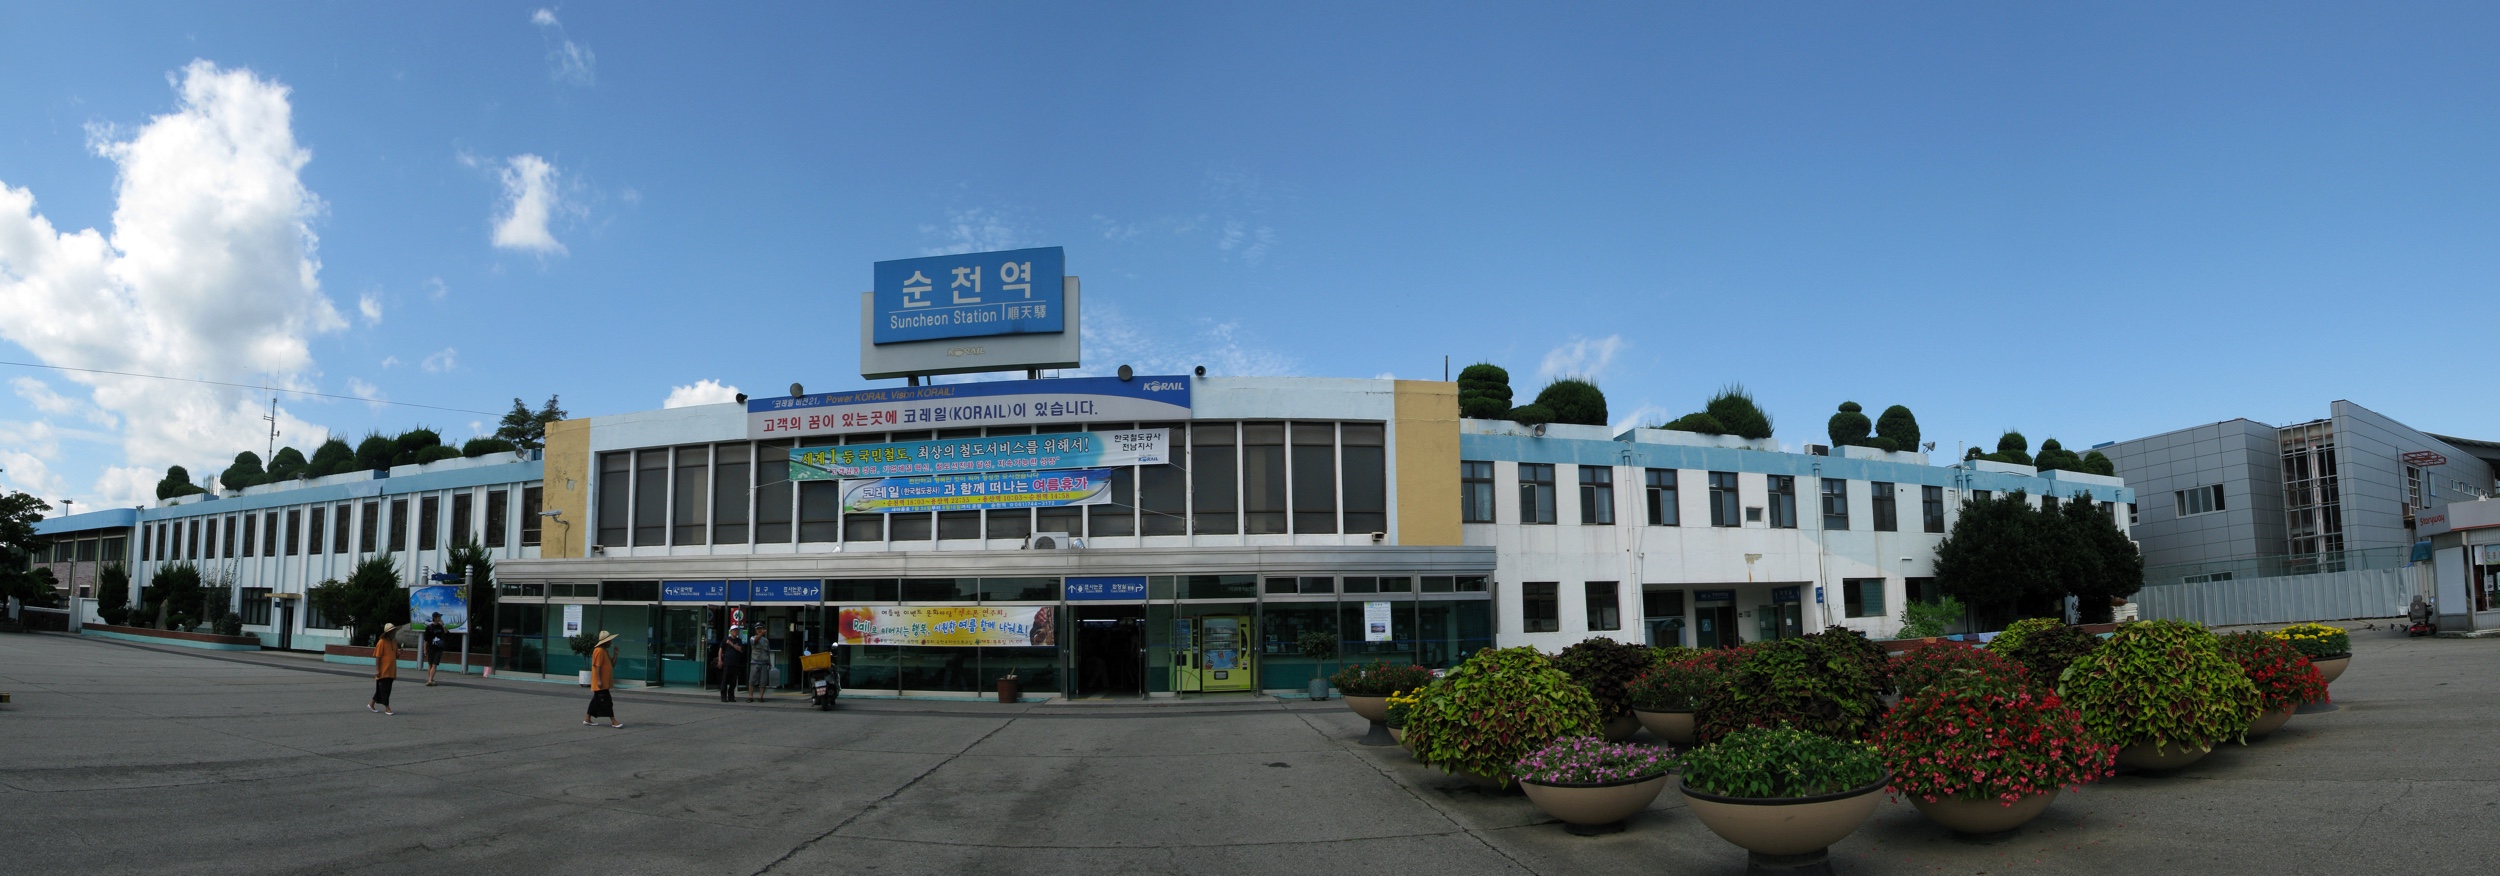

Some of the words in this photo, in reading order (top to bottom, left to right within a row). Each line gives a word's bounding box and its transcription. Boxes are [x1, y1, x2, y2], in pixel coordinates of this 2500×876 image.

[890, 313, 949, 329] Suncheon
[953, 309, 997, 325] Station
[1007, 304, 1047, 321] 順天驛
[946, 346, 986, 358] KORAIL
[1143, 380, 1184, 392] KORAIL
[825, 394, 852, 404] Power
[854, 391, 888, 402] KORAIL
[917, 387, 955, 398] KORAIL!
[763, 415, 801, 432] 고객의
[808, 413, 835, 430] 꿈이
[842, 410, 898, 428] 있는곳에
[903, 402, 1027, 423] 코레일(KORAIL)이
[1034, 399, 1098, 417] 있습니다.
[1114, 433, 1161, 443] 한국철도공사
[801, 450, 826, 467] 세계
[858, 447, 913, 464] 국민철도,
[917, 444, 955, 461] 최상의
[959, 439, 1039, 459] 철도서비스를
[1043, 437, 1090, 453] 위해서!
[1122, 442, 1154, 452] 전남지사
[882, 463, 913, 475] 기업체질
[935, 460, 974, 471] 철도선진화
[997, 457, 1038, 468] 지속가능한
[960, 481, 985, 496] 함께
[989, 480, 1029, 494] 떠나는
[1033, 476, 1089, 491] 여름휴가
[951, 496, 970, 504] 22:55
[1050, 492, 1070, 500] 14:58
[903, 609, 923, 618] 이벤트
[852, 618, 878, 634] Rail로
[880, 625, 910, 638] 이어지는
[911, 622, 931, 637] 행복,
[933, 620, 957, 635] 시원한
[958, 618, 978, 633] 여름
[979, 618, 997, 633] 함께
